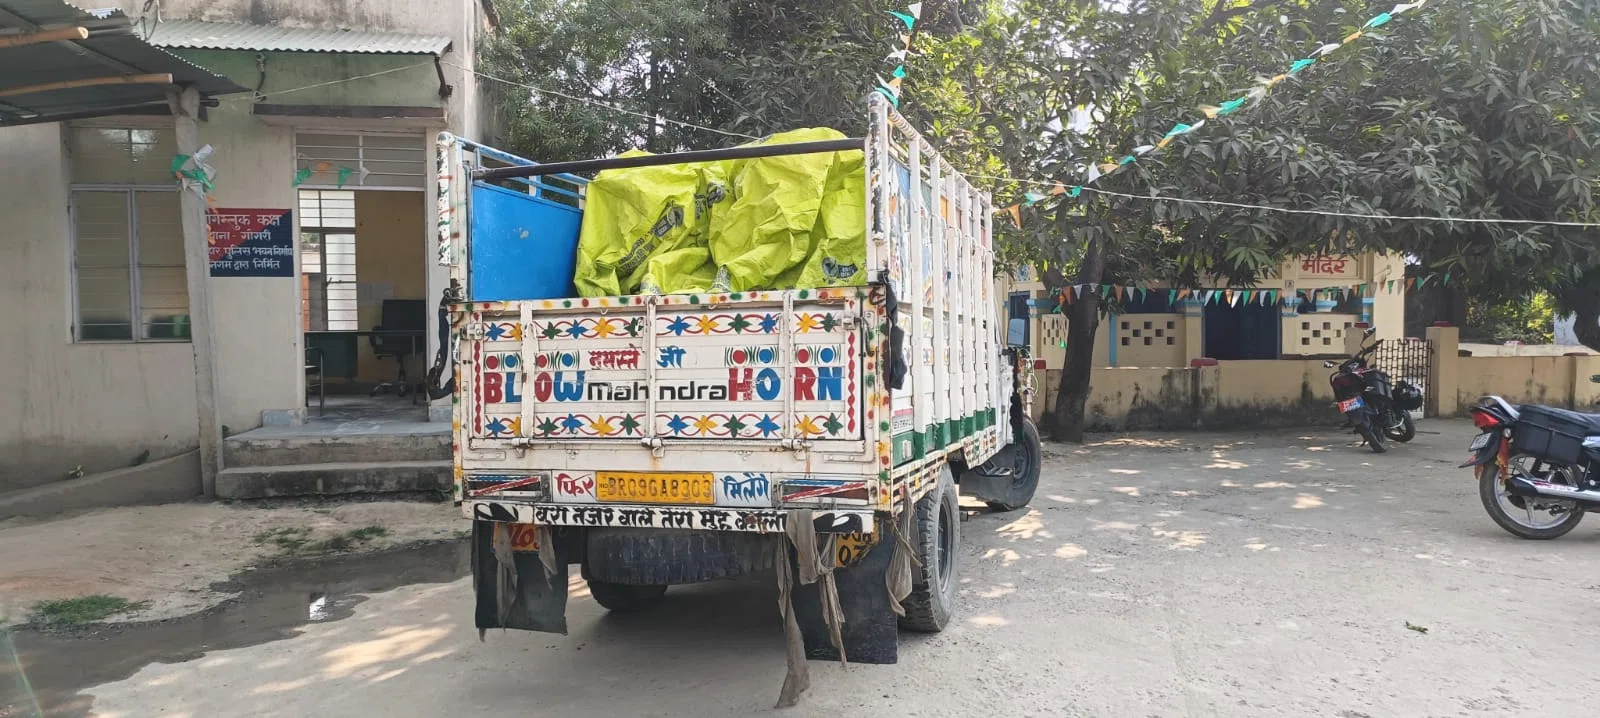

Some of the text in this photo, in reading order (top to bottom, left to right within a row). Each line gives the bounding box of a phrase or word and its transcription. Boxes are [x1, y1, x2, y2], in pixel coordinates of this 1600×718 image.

[207, 214, 282, 231] गन्तुक कक्ष
[223, 244, 250, 259] पुलिस
[252, 246, 272, 256] भवन
[1302, 254, 1349, 274] मंदिर
[483, 366, 843, 404] BLOW mahndra HORN
[553, 472, 596, 500] फिर
